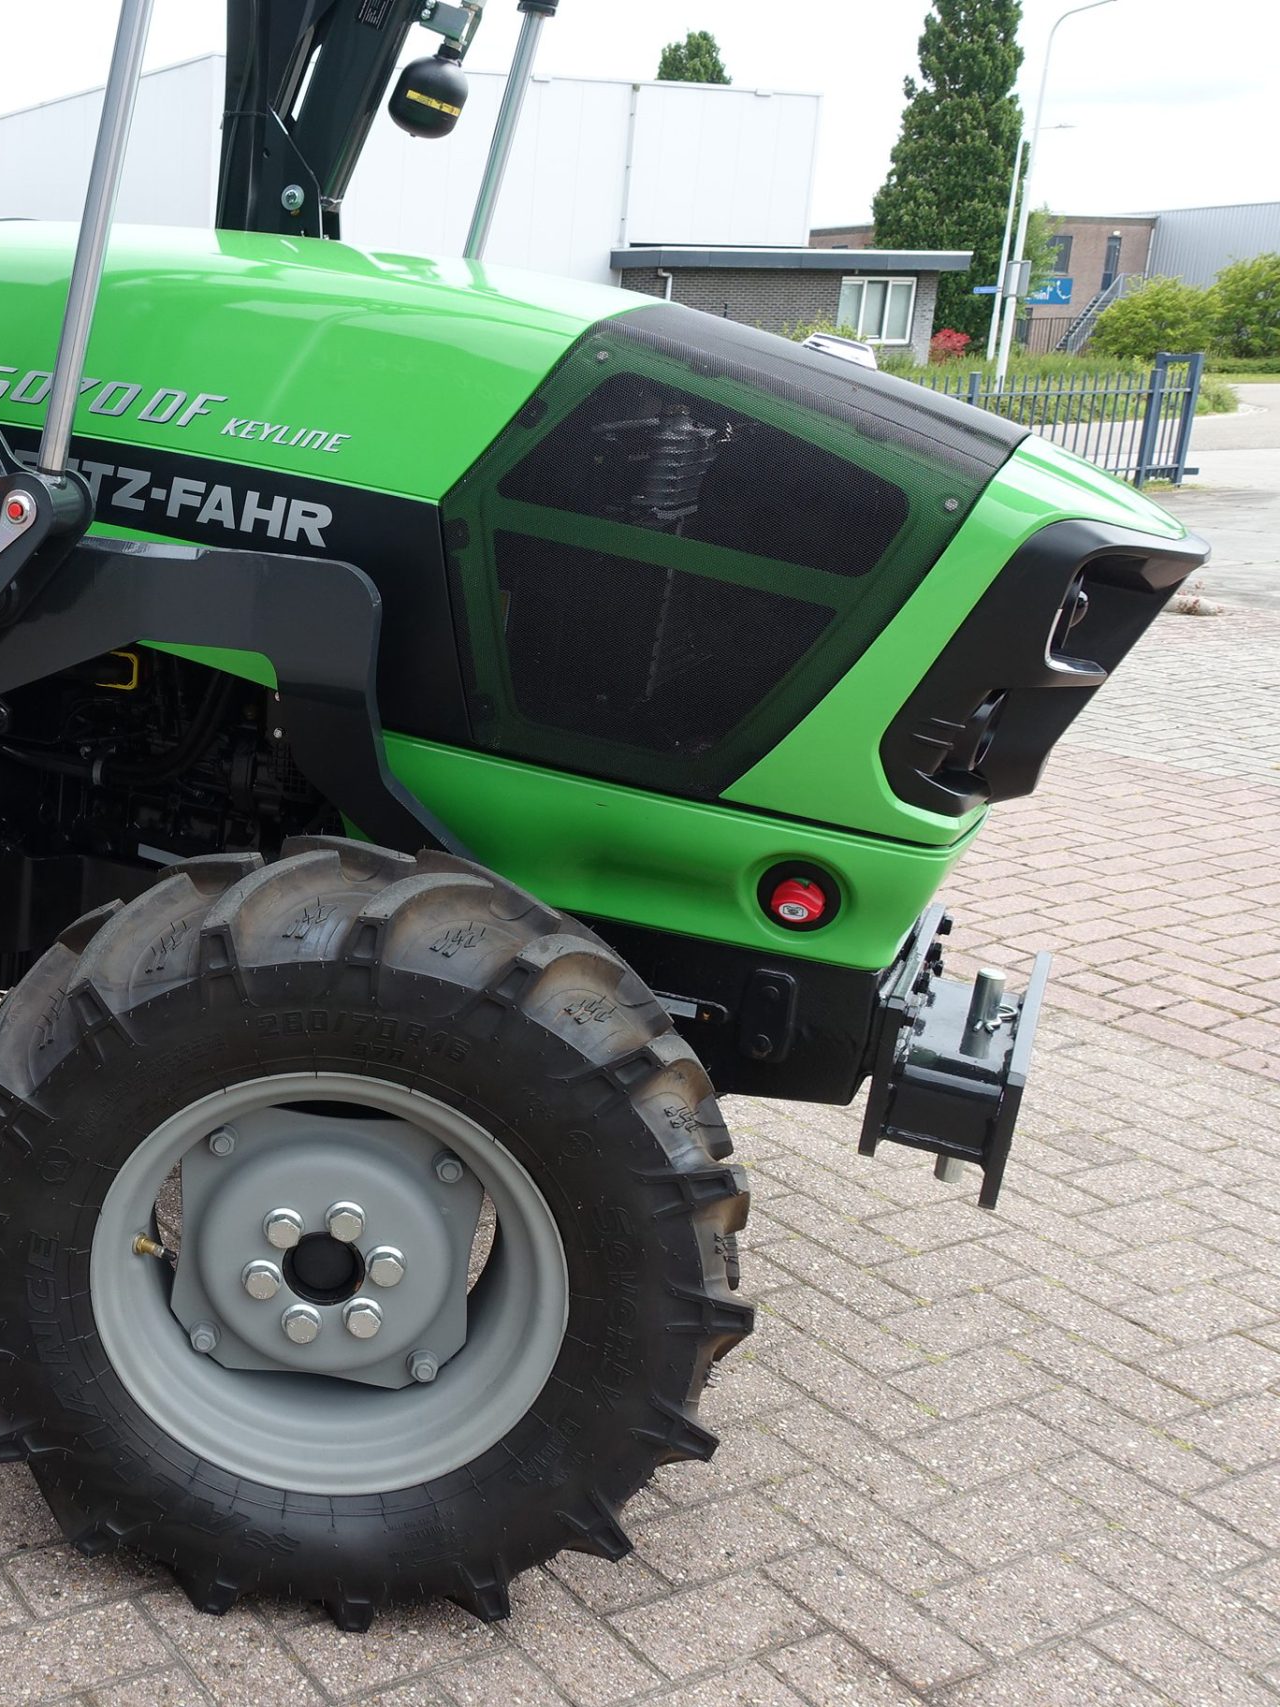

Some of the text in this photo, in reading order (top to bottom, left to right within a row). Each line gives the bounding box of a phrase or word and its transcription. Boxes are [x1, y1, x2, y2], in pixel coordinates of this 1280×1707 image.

[138, 388, 228, 427] DF
[220, 417, 352, 453] KEYLINE
[14, 449, 333, 548] TZ-FAHR
[24, 1228, 252, 1537] ALLIANCE
